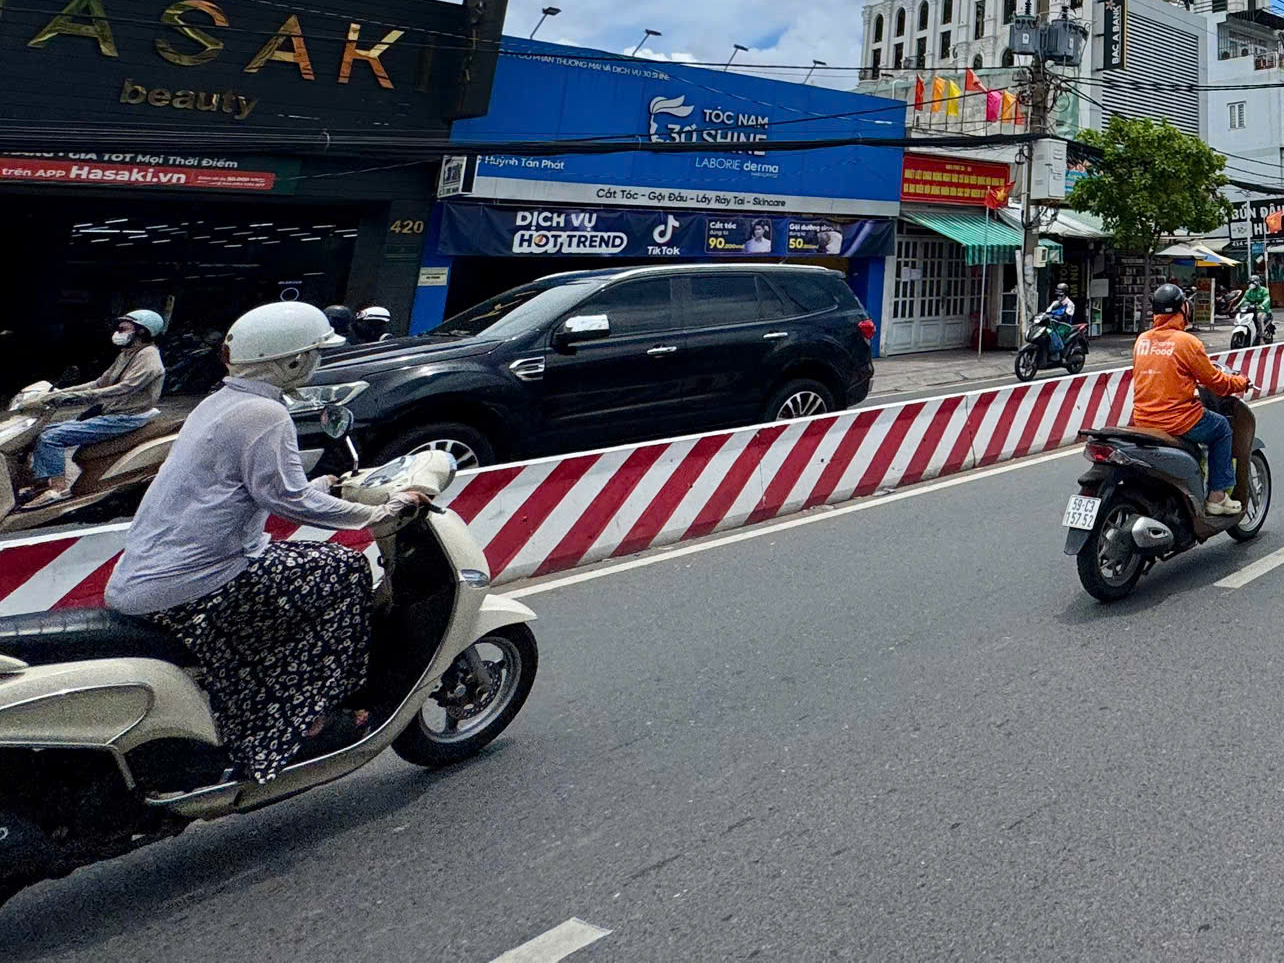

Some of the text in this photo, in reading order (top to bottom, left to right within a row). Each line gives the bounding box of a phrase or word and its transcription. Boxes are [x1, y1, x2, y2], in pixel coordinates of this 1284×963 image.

[1112, 5, 1121, 32] BANK
[120, 78, 258, 120] beauty
[704, 106, 769, 128] TÓC NAM
[136, 154, 163, 165] Mọi
[167, 156, 199, 167] Thời
[201, 157, 238, 169] Điểm
[541, 159, 565, 170] Phát
[696, 157, 779, 173] LABORIE derma
[2, 167, 32, 177] trên
[35, 169, 66, 178] APP
[69, 165, 187, 184] Hasaki.vn
[620, 189, 639, 200] Tóc
[733, 196, 745, 205] Tai
[752, 198, 786, 207] Skincare
[390, 220, 424, 233] 420
[516, 211, 597, 231] DỊCH VỤ
[518, 233, 625, 248] HOT TREND
[647, 246, 680, 255] TikTok
[1151, 347, 1175, 356] Food
[1072, 498, 1096, 513] 59-C3
